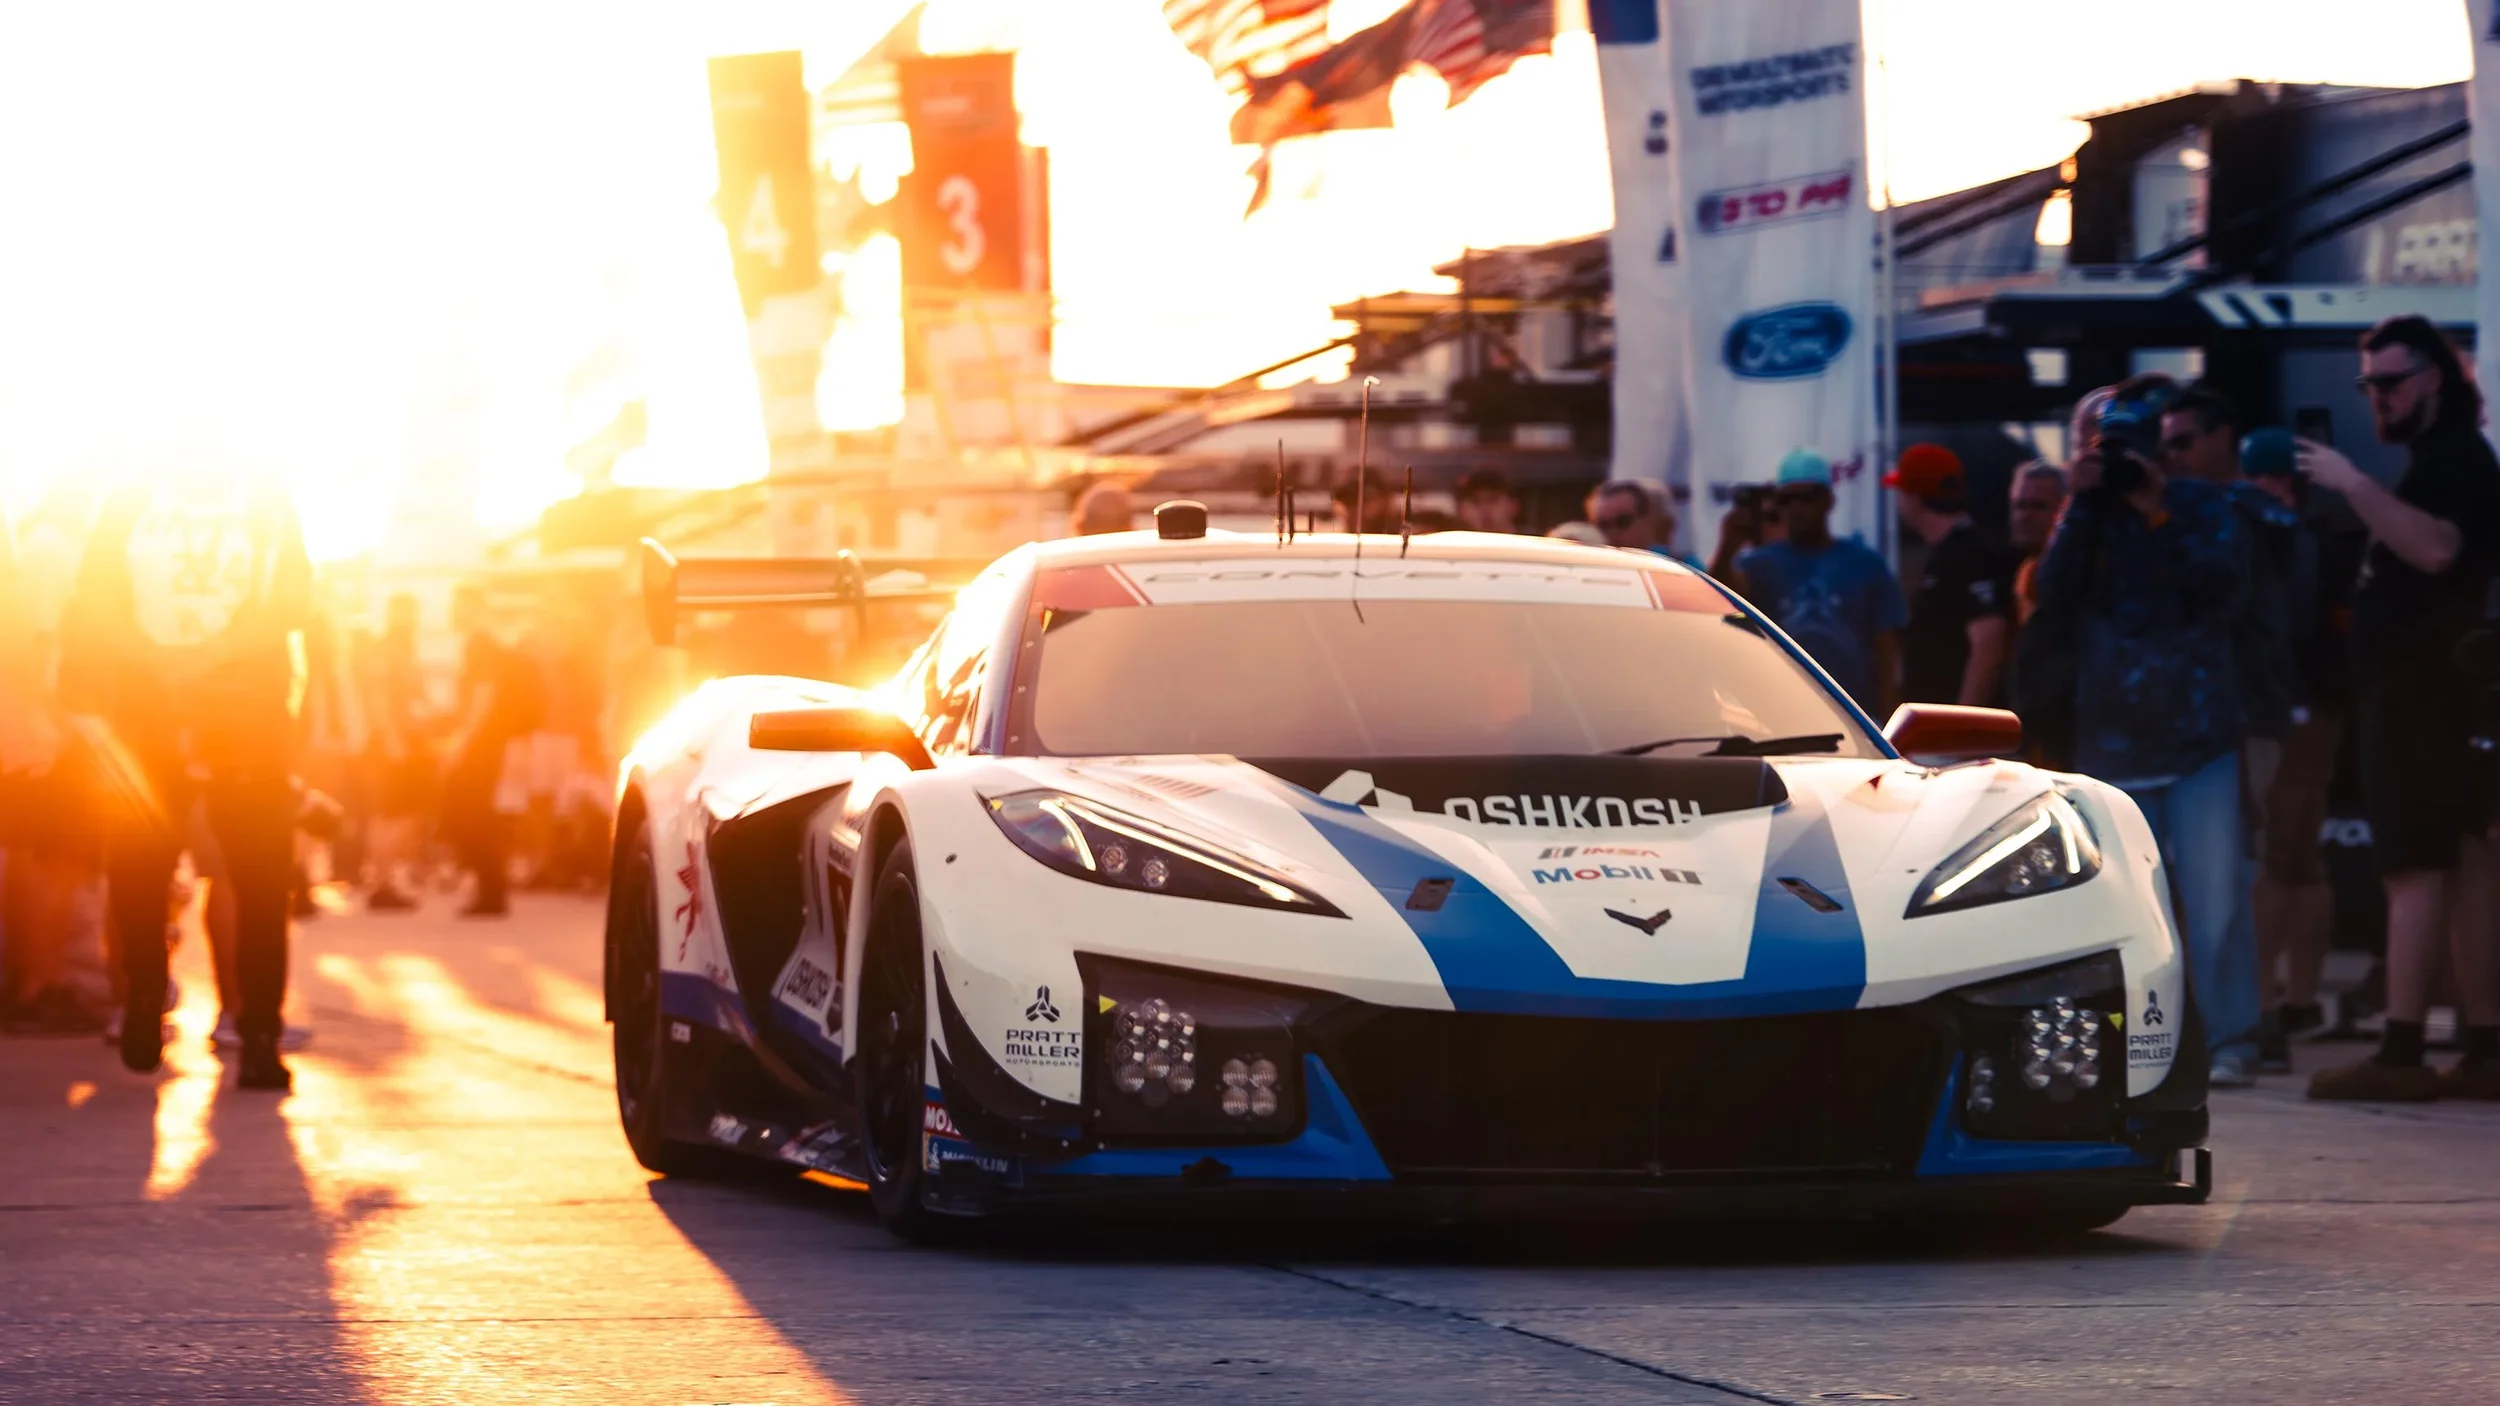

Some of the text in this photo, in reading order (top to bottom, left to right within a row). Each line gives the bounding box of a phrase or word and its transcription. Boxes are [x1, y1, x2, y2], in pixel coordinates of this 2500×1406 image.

[740, 173, 788, 268] 4
[937, 174, 985, 274] 3
[1444, 795, 1702, 829] OSHKOSH
[1582, 847, 1660, 858] IMSA
[1532, 865, 1655, 884] Mobil
[1006, 1029, 1081, 1043] PRATT
[2129, 1033, 2172, 1046] PRATT
[1006, 1043, 1080, 1058] MILLER
[2129, 1047, 2172, 1060] MILLER
